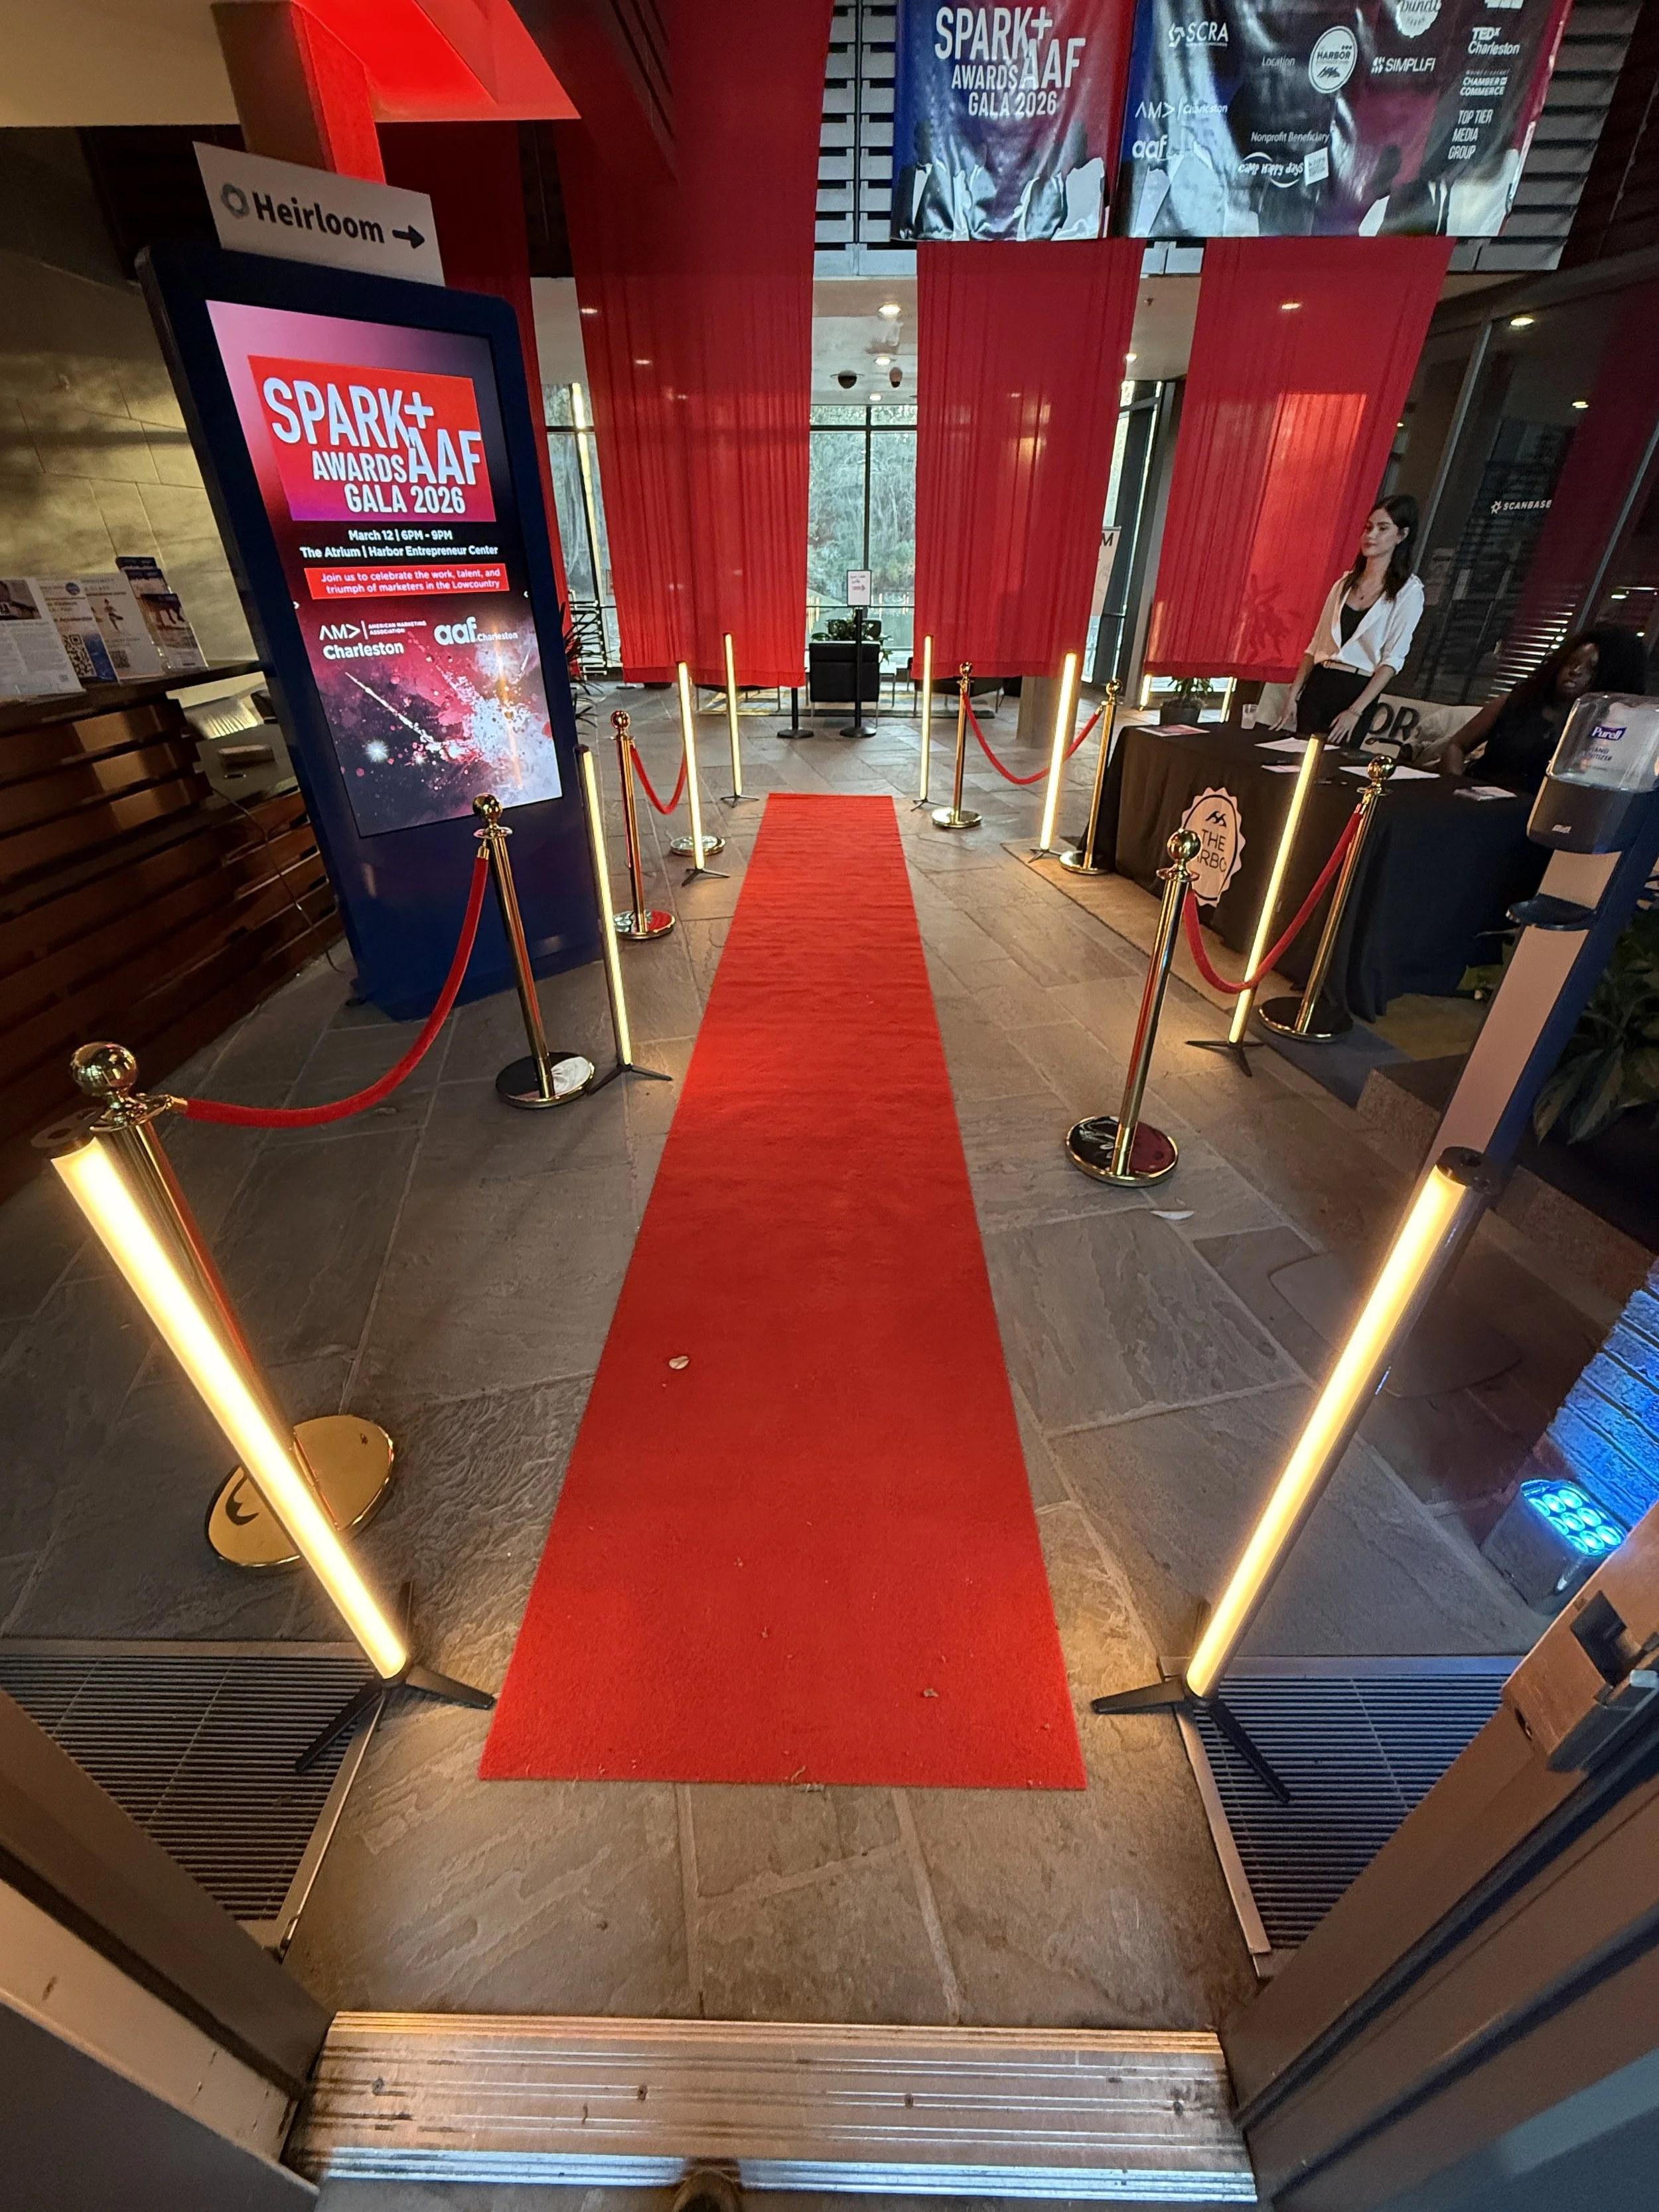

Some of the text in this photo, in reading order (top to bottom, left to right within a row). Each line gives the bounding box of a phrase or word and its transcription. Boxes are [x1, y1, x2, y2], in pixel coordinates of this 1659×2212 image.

[934, 6, 1052, 61] SPARK+
[1187, 21, 1228, 42] SCRA
[1317, 51, 1350, 60] HARBOR
[1468, 40, 1520, 55] Charleston
[951, 38, 1086, 92] AWARDS AAF
[1262, 53, 1295, 66] Location
[1462, 76, 1500, 86] CHAMBER
[1460, 86, 1505, 96] COMMERCE
[969, 90, 1057, 118] GALA 2026
[1457, 109, 1493, 125] TOP TIER
[1251, 130, 1329, 144] Nonprofit Beneficiary
[1452, 127, 1479, 142] MEDIA
[1132, 135, 1168, 159] aaf
[1448, 145, 1476, 159] GROUP
[252, 190, 385, 244] Heirloom
[263, 376, 434, 449] SPARK+
[312, 427, 481, 485] AWARDS AAF
[344, 484, 465, 514] GALA 2026
[1502, 499, 1553, 510] SCANBASE
[348, 530, 382, 541] March
[382, 530, 394, 541] 12
[401, 530, 424, 540] 6PM
[431, 530, 453, 540] 9PM
[299, 546, 323, 558] The
[325, 546, 361, 557] Atrium
[368, 546, 404, 557] Harbor
[405, 546, 467, 557] Entrepreneur
[468, 545, 498, 555] Center
[321, 573, 342, 583] Join
[356, 572, 368, 581] to
[370, 571, 413, 581] celebrate
[414, 570, 429, 579] the
[431, 569, 455, 579] work,
[457, 569, 483, 579] talent,
[485, 568, 501, 577] and
[326, 579, 500, 595] triumph of marketers in the Lowcountry
[434, 617, 518, 646] aaf Charleston
[323, 640, 404, 660] Charleston
[1592, 727, 1623, 739] Purell
[1202, 829, 1226, 852] THE
